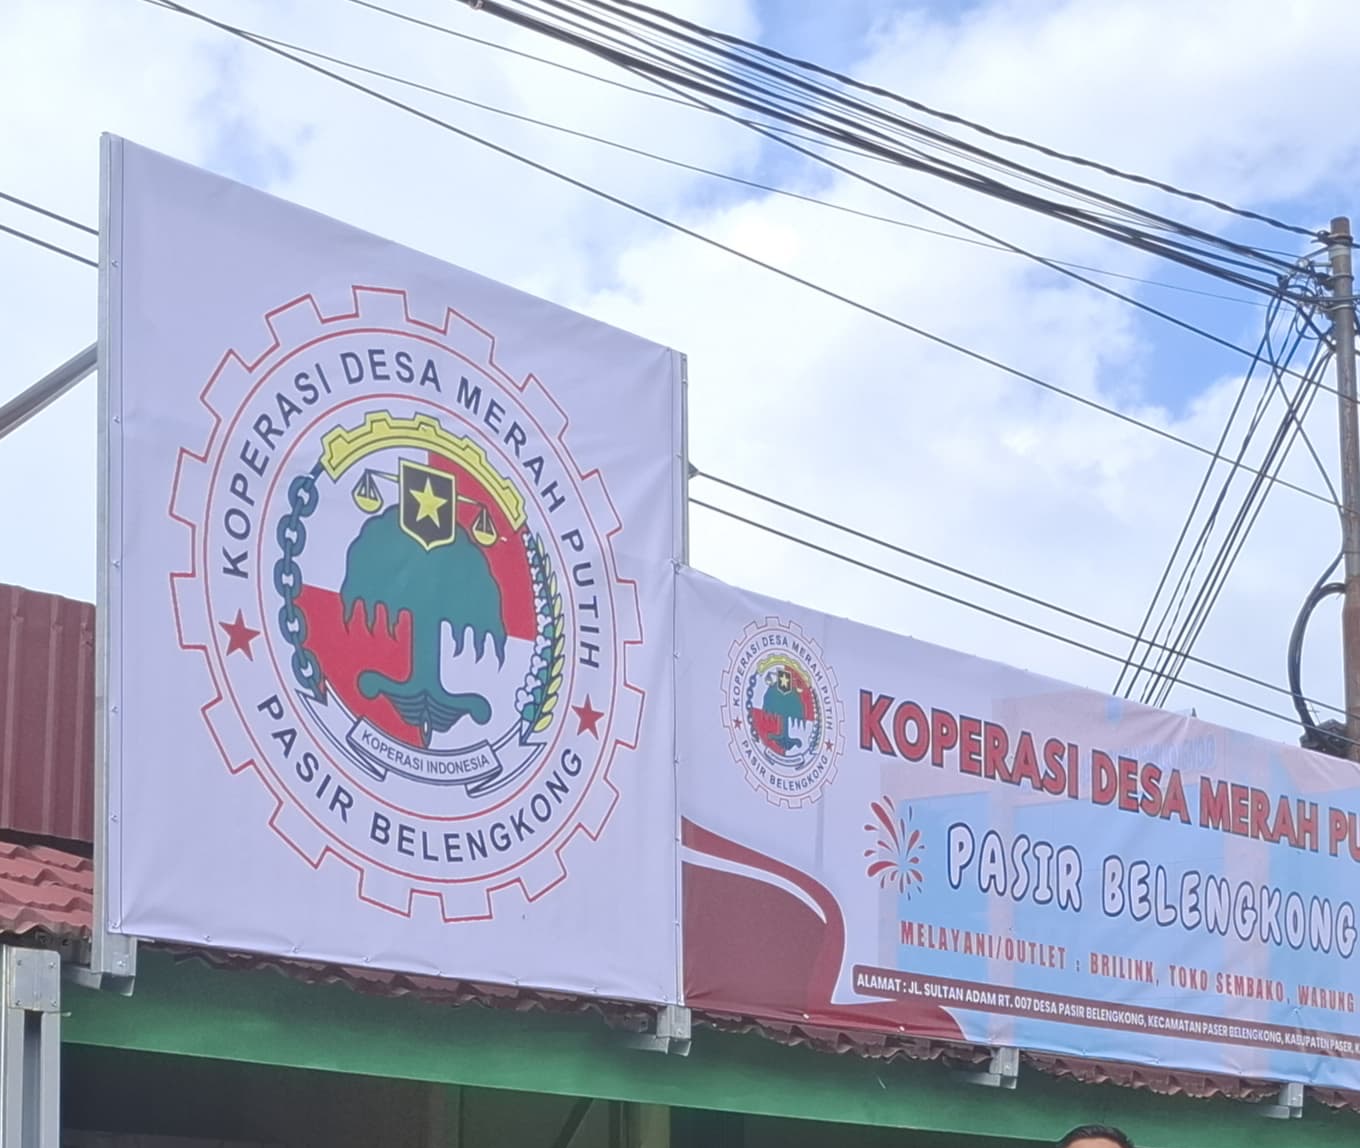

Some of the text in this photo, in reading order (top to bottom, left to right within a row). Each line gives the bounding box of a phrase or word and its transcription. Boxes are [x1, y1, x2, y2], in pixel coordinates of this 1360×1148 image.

[220, 347, 600, 672] KOPERASI DESA MERAH PUTIH
[733, 635, 833, 730] KOPERASI DESA MERAH PUTIH
[257, 695, 584, 864] PASIR BELENGKONG
[362, 729, 490, 775] KOPERASI INDONESIA
[742, 740, 766, 777] PASIR
[770, 754, 828, 791] BELENGKONG
[860, 688, 1079, 800] KOPERASI
[1091, 749, 1192, 825] DESA
[1199, 776, 1320, 852] MERAH
[946, 822, 1358, 960] PASIR BELENGKONG
[901, 920, 1066, 970] MELAYANI/OUTLET
[1090, 952, 1159, 986] BRILINK,
[1169, 964, 1208, 991] TOKO
[1216, 972, 1290, 1005] SEMBAKO,
[1297, 984, 1355, 1013] WARUNG
[907, 981, 923, 995] JL.
[924, 983, 964, 1001] SULTAN
[965, 990, 997, 1005] ADAM
[998, 994, 1013, 1008] RT.
[1014, 996, 1032, 1010] 007
[1033, 999, 1057, 1014] DESA
[1058, 1003, 1085, 1018] PASIR
[1086, 1006, 1147, 1028] BELENGKONG,
[1148, 1015, 1202, 1034] KECAMATAN
[1202, 1024, 1228, 1036] PASER
[1229, 1025, 1284, 1045] BELENGKONG,
[1285, 1032, 1330, 1050] KABUPATEN
